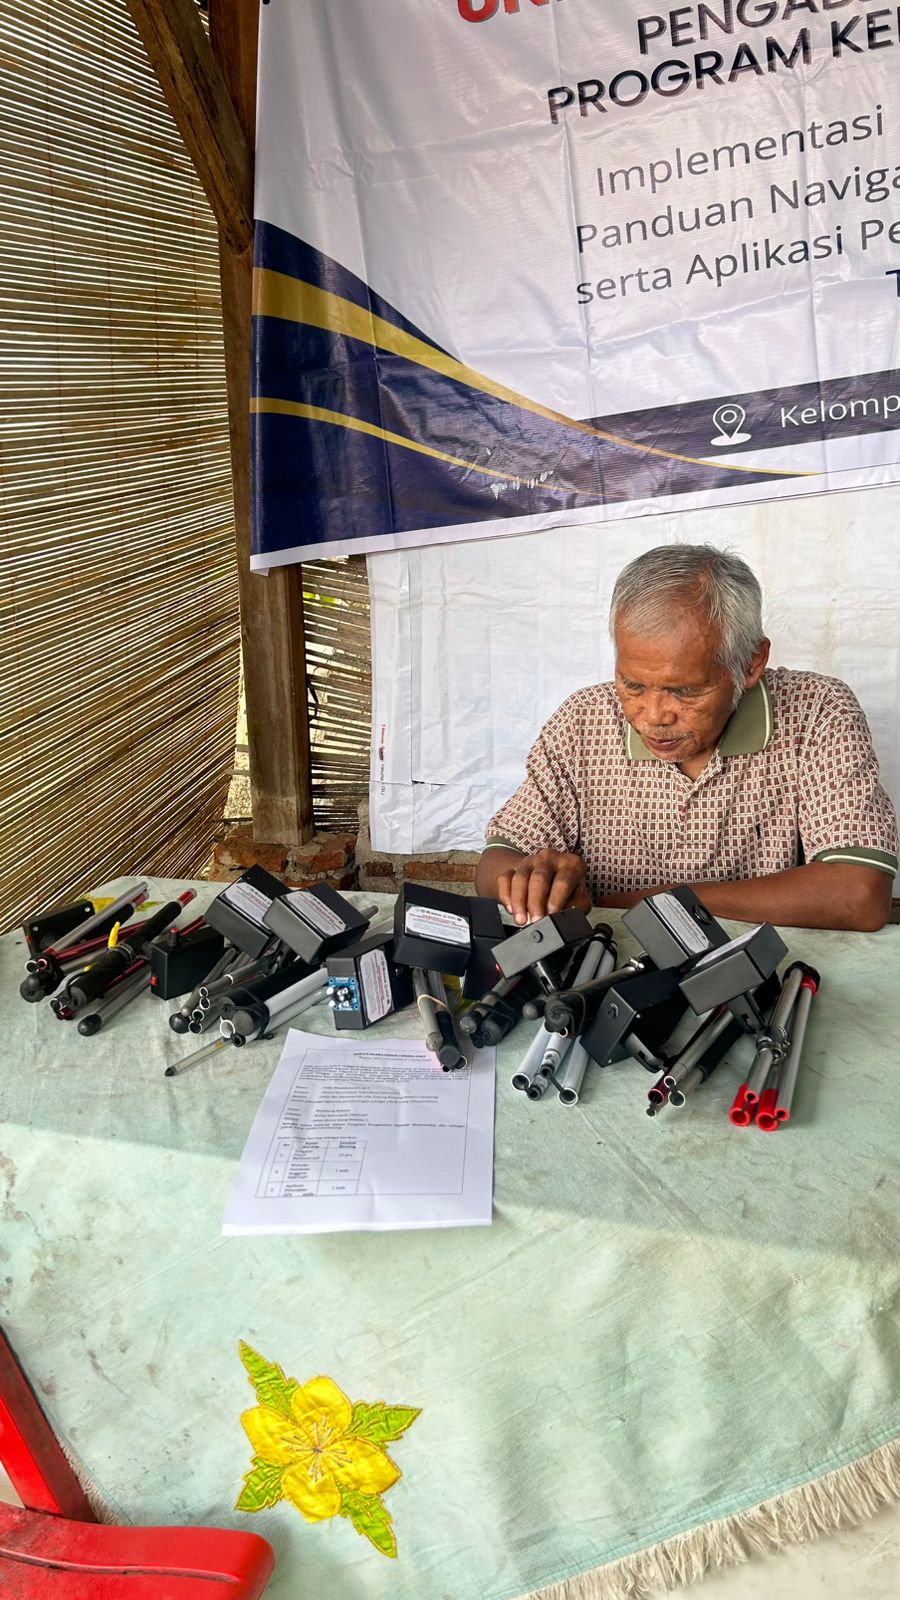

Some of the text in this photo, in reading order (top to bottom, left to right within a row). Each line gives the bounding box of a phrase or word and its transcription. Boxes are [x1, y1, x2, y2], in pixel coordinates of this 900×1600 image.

[547, 7, 900, 124] PROGRAM KE
[597, 104, 884, 196] Implementasi
[577, 196, 753, 253] Panduan
[576, 266, 672, 305] serta
[686, 225, 843, 287] Aplikasi
[781, 395, 900, 428] Kelomp
